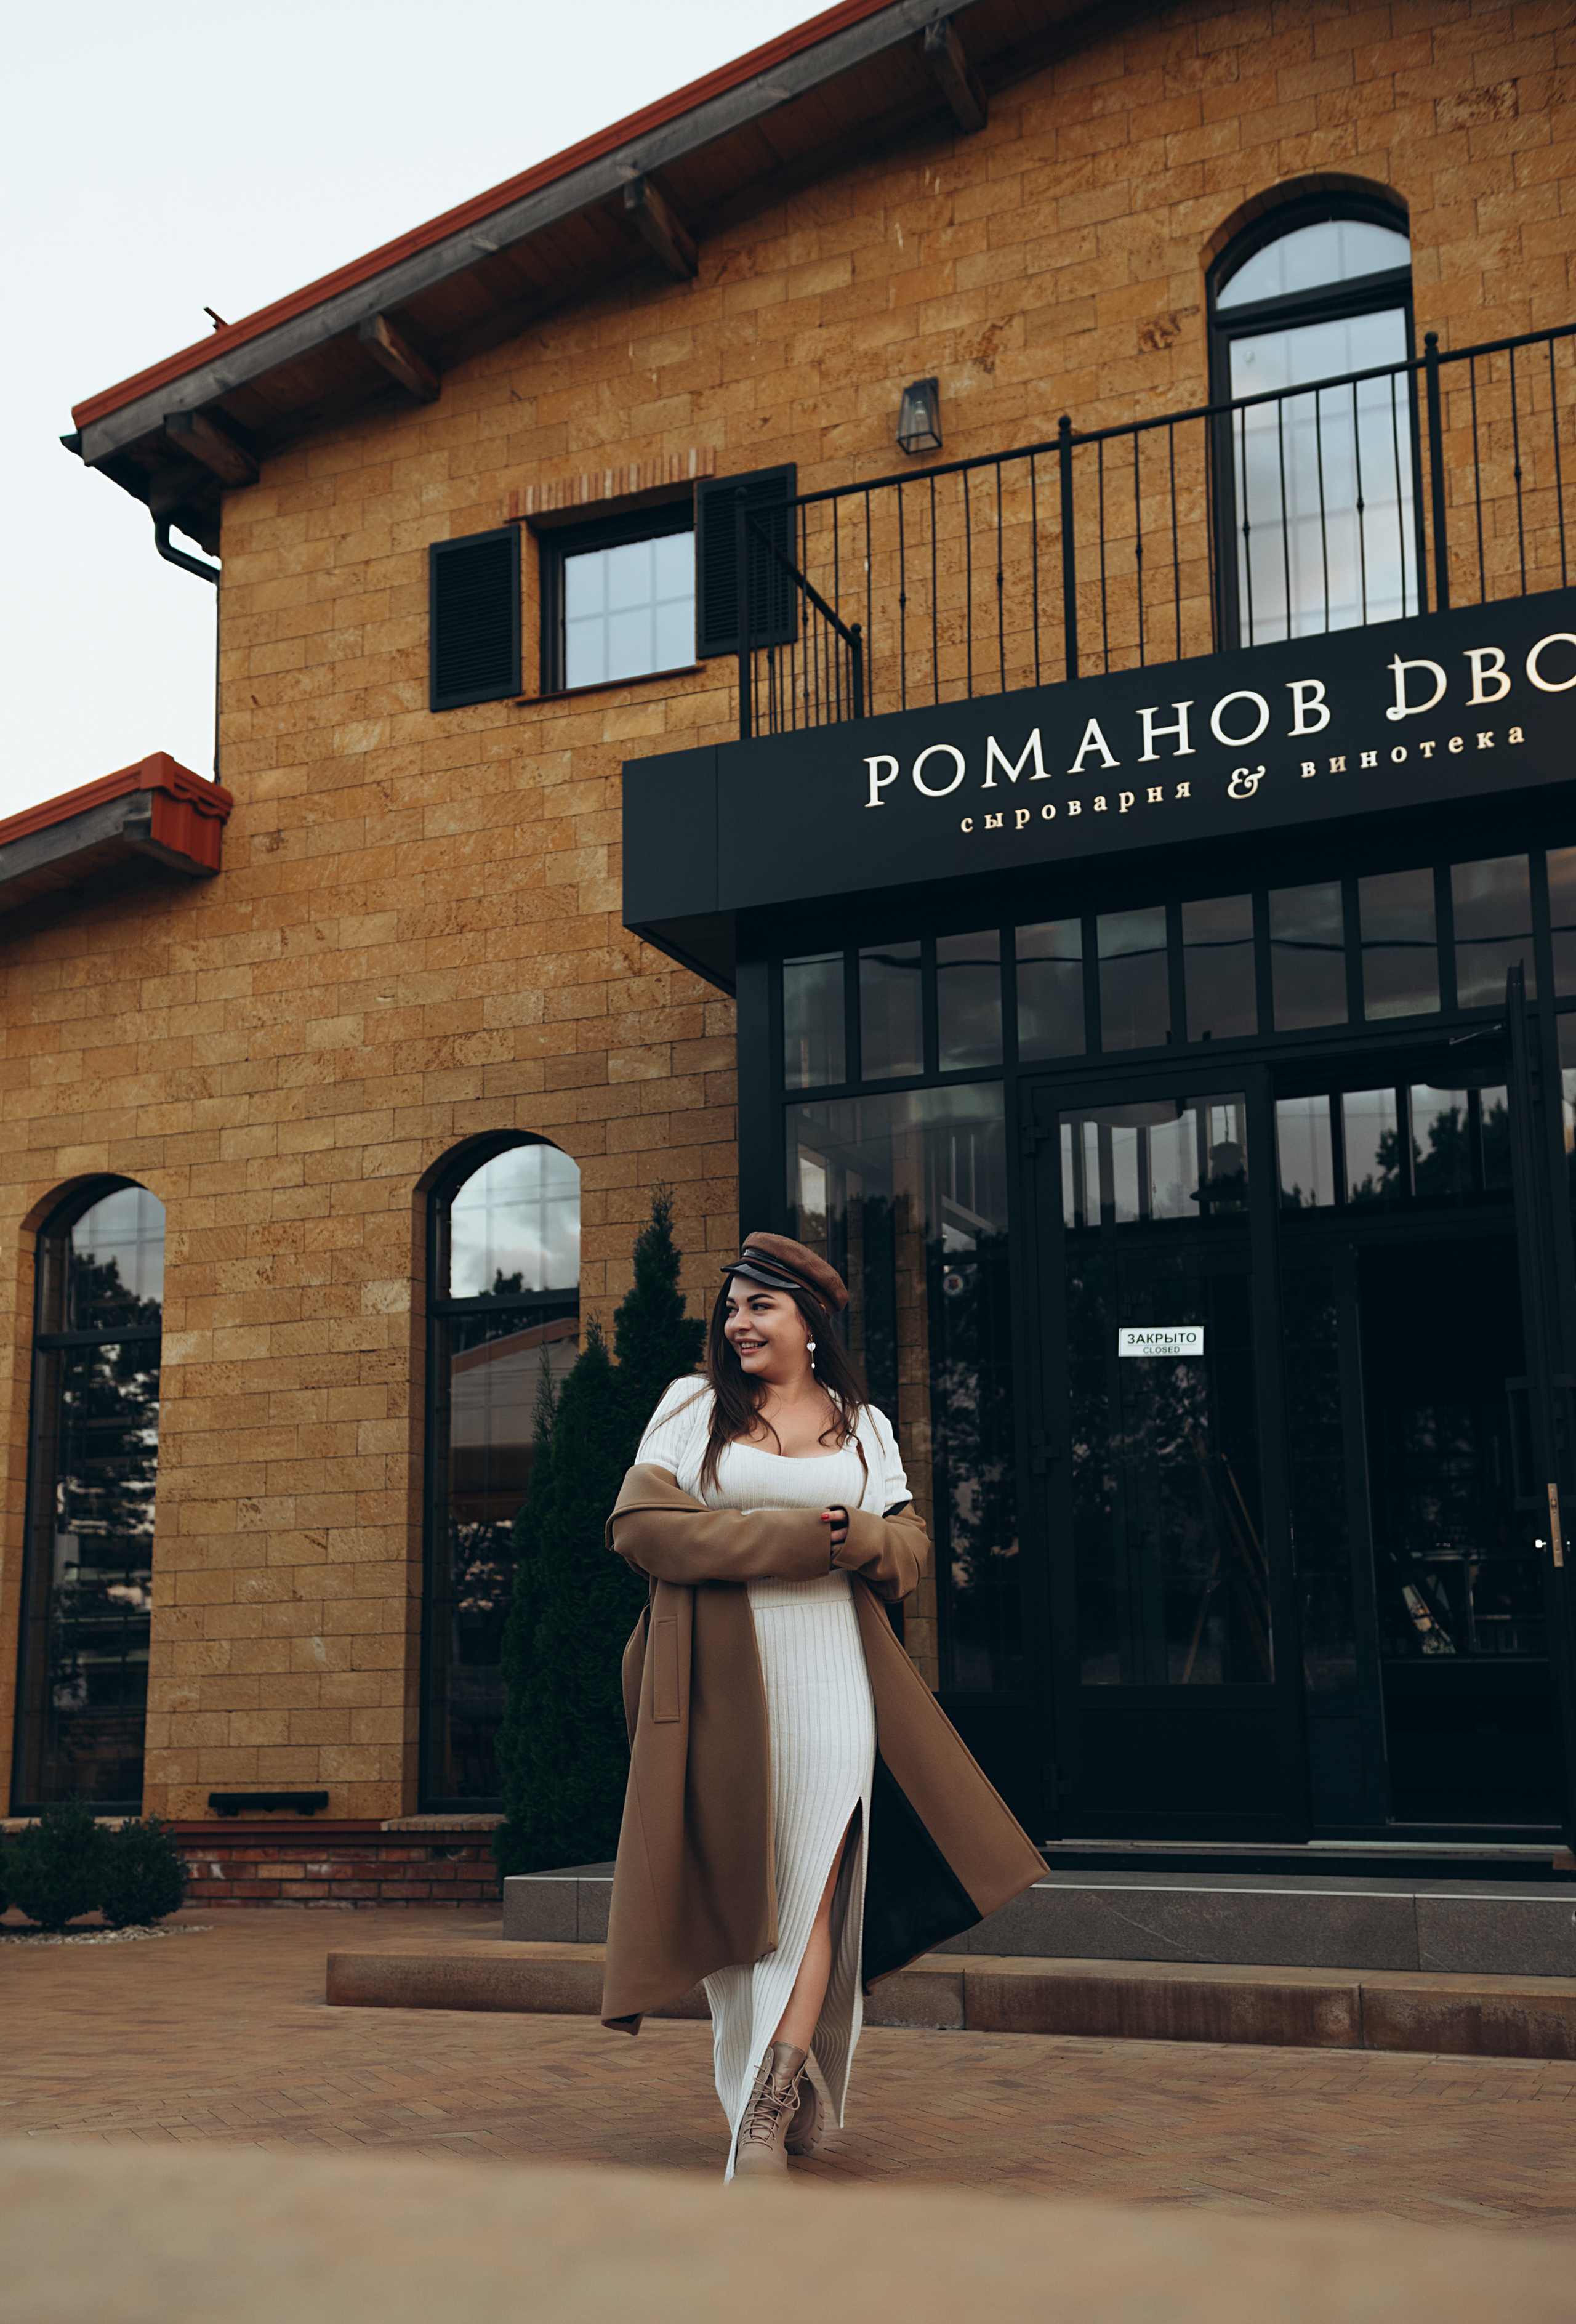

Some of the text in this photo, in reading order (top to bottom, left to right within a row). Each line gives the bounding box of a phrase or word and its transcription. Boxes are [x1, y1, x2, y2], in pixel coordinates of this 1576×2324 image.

[863, 679, 1330, 807] РОМАНОВ
[960, 727, 1525, 833] сыроварня & винотека
[1127, 1333, 1196, 1344] ЗАКРЫТО
